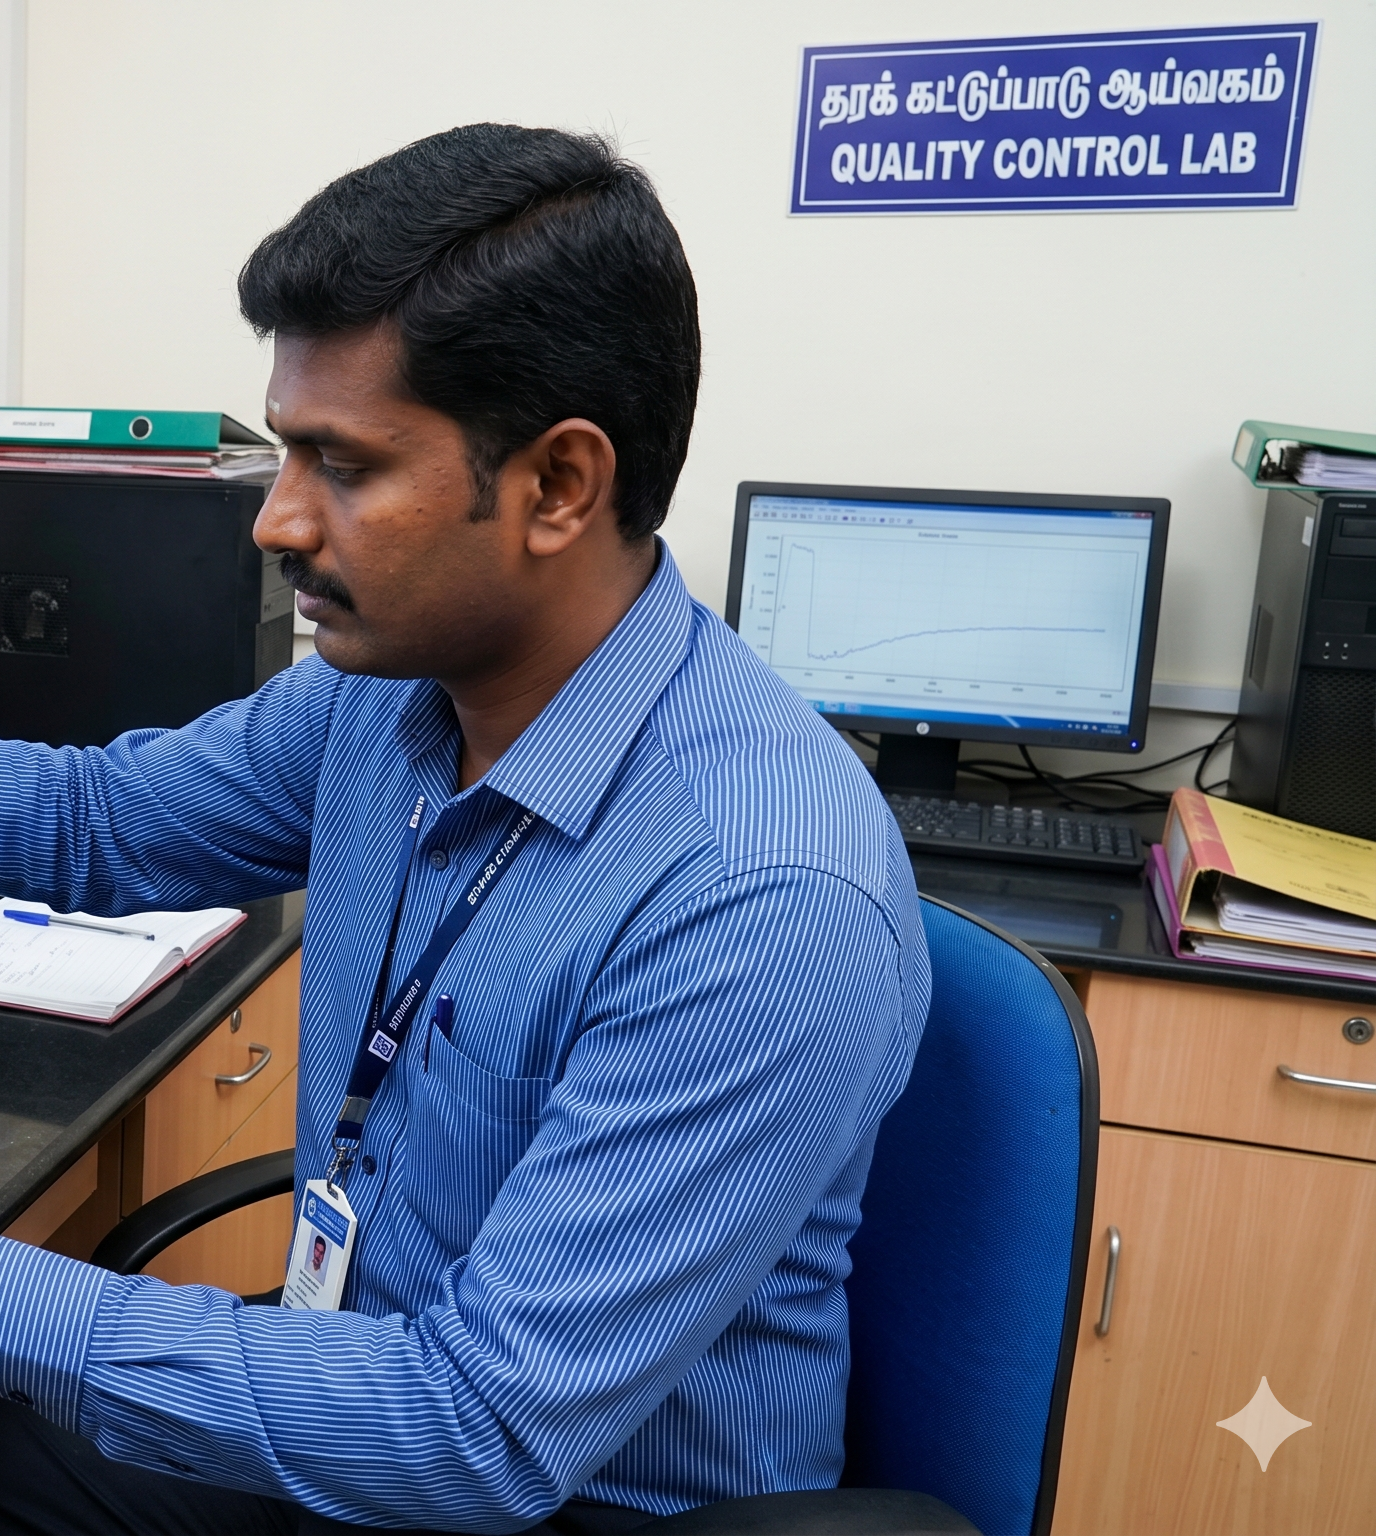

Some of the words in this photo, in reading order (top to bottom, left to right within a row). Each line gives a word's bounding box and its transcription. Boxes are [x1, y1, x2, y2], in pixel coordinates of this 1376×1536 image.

[819, 70, 898, 130] தரக்
[905, 65, 1091, 121] கட்டுப்பாடு
[1098, 53, 1285, 115] ஆய்வகம்
[831, 140, 985, 185] QUALITY
[993, 135, 1169, 180] CONTROL
[1180, 131, 1257, 175] LAB
